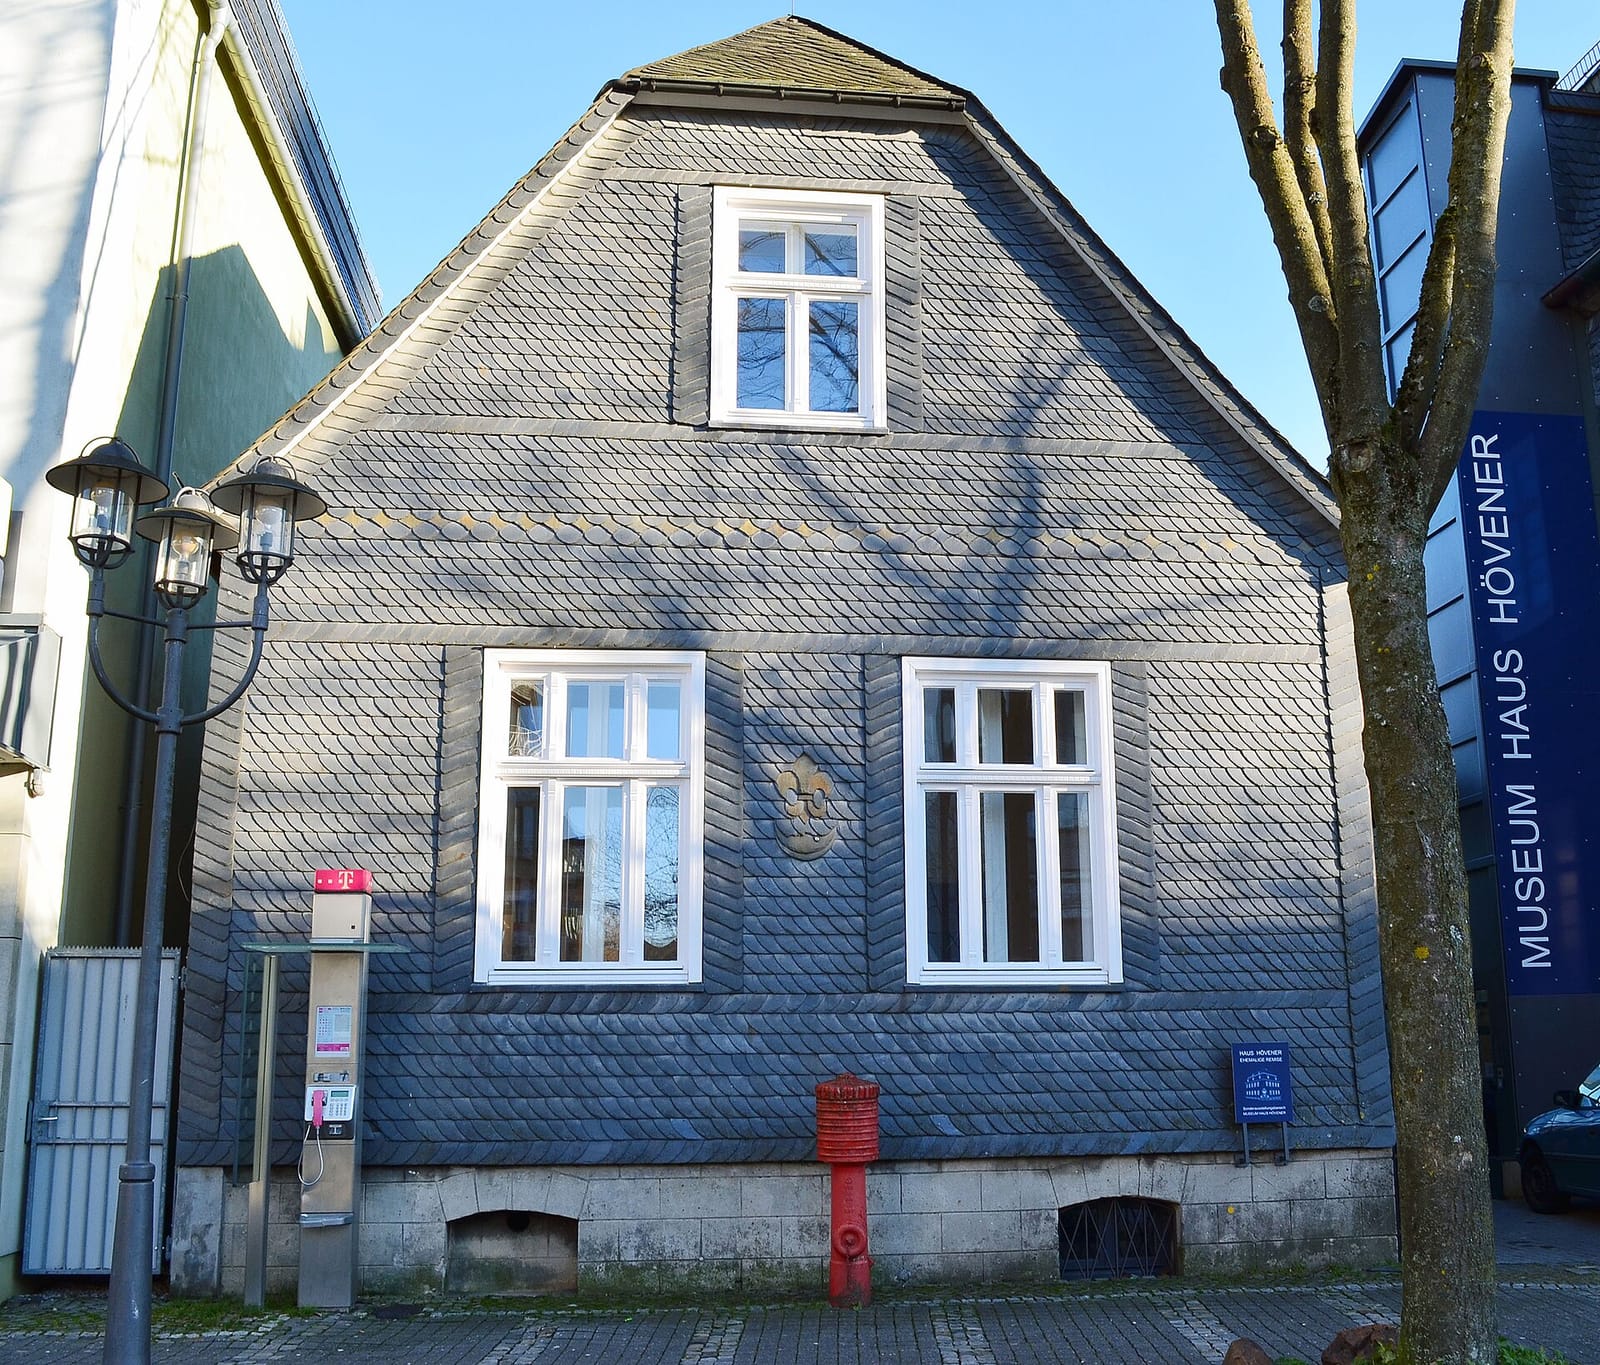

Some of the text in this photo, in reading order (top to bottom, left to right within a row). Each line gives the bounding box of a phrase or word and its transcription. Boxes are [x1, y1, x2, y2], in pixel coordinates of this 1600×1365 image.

[1471, 434, 1552, 969] MUSEUM HAUS HÖVENER
[338, 871, 354, 890] T
